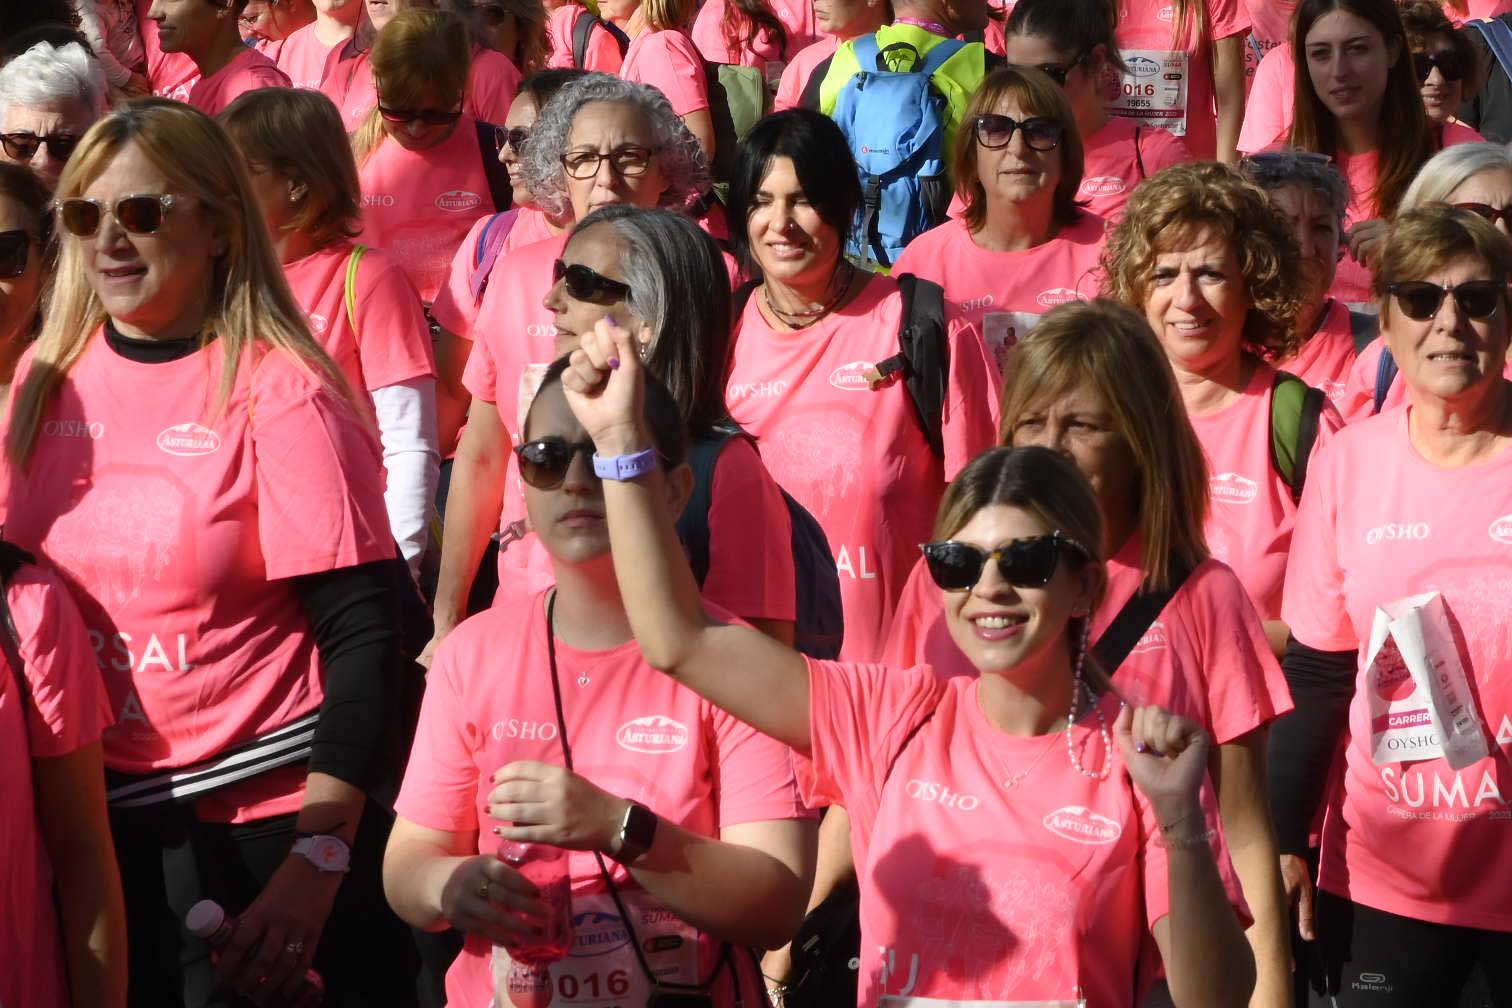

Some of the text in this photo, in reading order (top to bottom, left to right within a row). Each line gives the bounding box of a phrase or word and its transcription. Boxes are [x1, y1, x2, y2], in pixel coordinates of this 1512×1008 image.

[1124, 83, 1155, 96] 016
[43, 420, 104, 440] OYSHO
[1380, 767, 1505, 809] SUMA
[1051, 815, 1115, 839] ASTURIANA
[558, 970, 630, 999] 016
